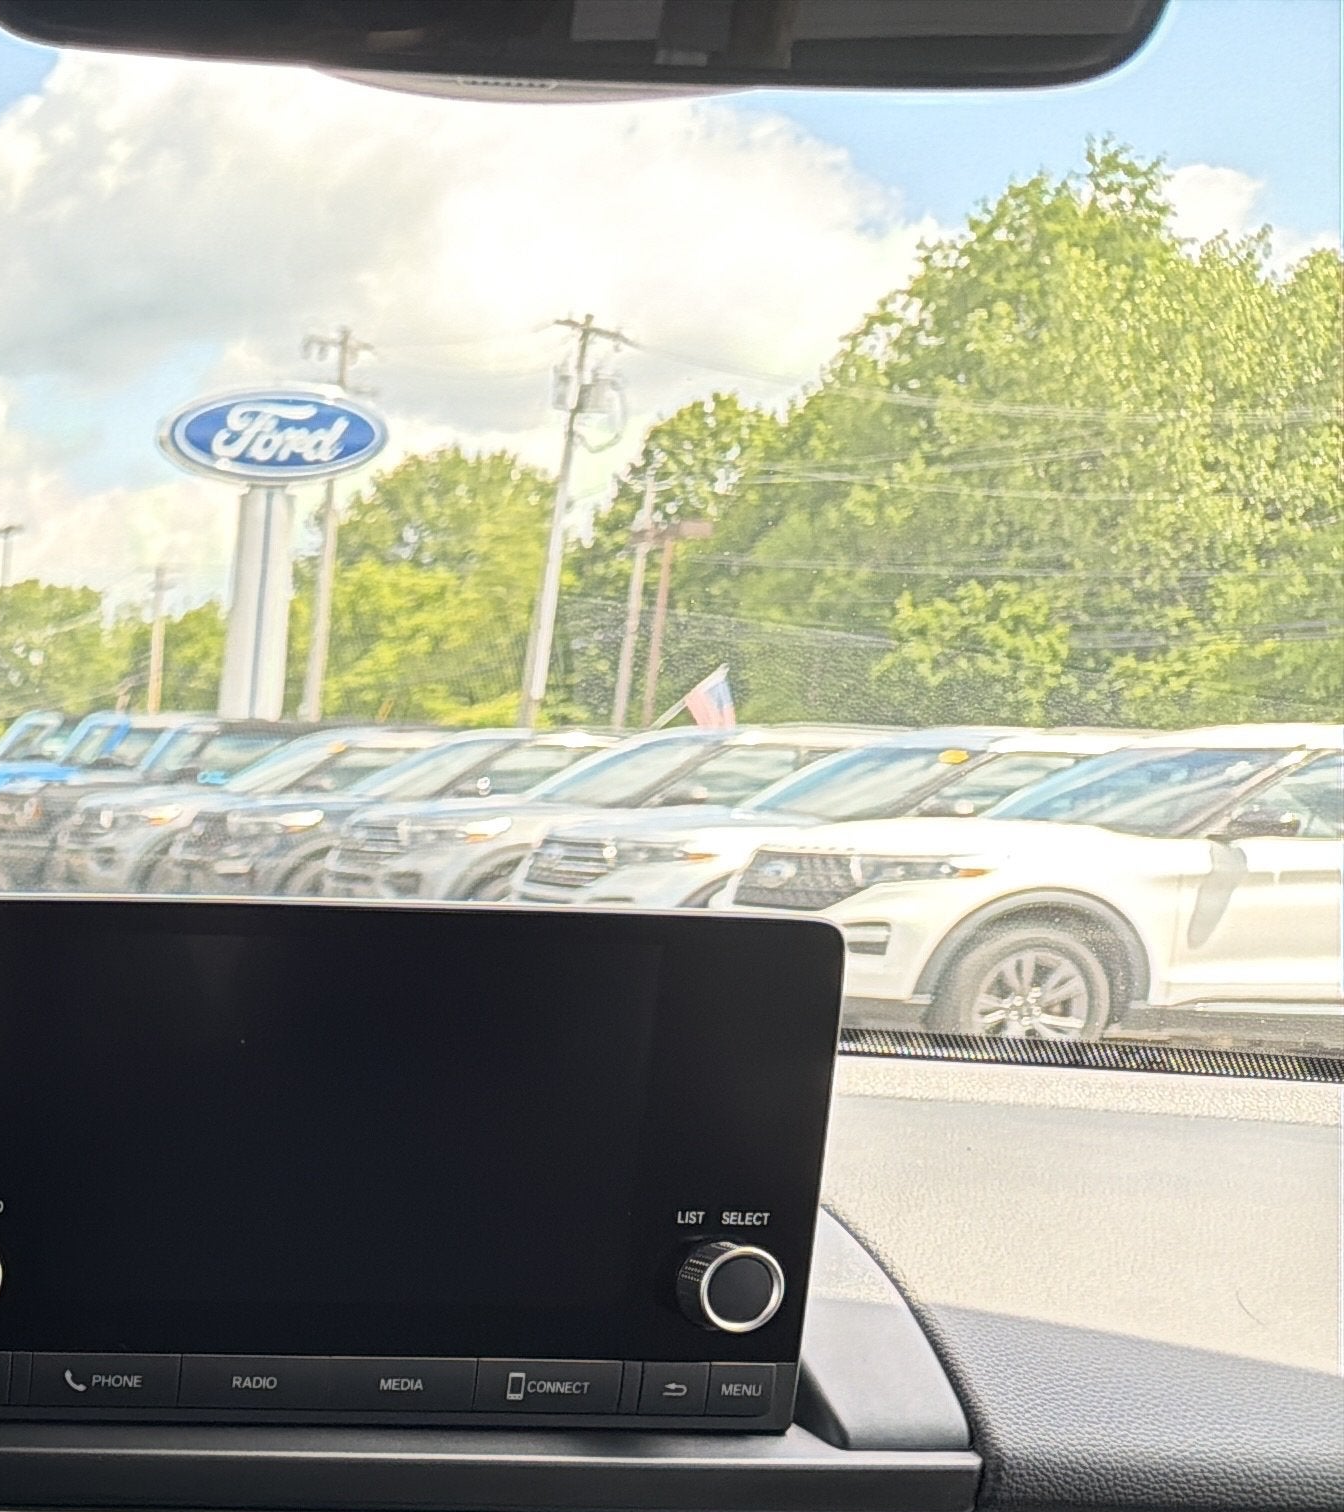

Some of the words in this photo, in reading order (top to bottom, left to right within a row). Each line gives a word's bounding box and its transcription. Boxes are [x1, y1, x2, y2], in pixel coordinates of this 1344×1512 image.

[211, 401, 350, 463] Ford
[677, 1211, 705, 1224] LIST
[721, 1211, 770, 1226] SELECT
[91, 1374, 142, 1389] PHONE
[232, 1376, 278, 1390] RADIO
[379, 1378, 424, 1392] MEDIA
[527, 1380, 590, 1395] CONNECT
[721, 1383, 762, 1397] MENU
